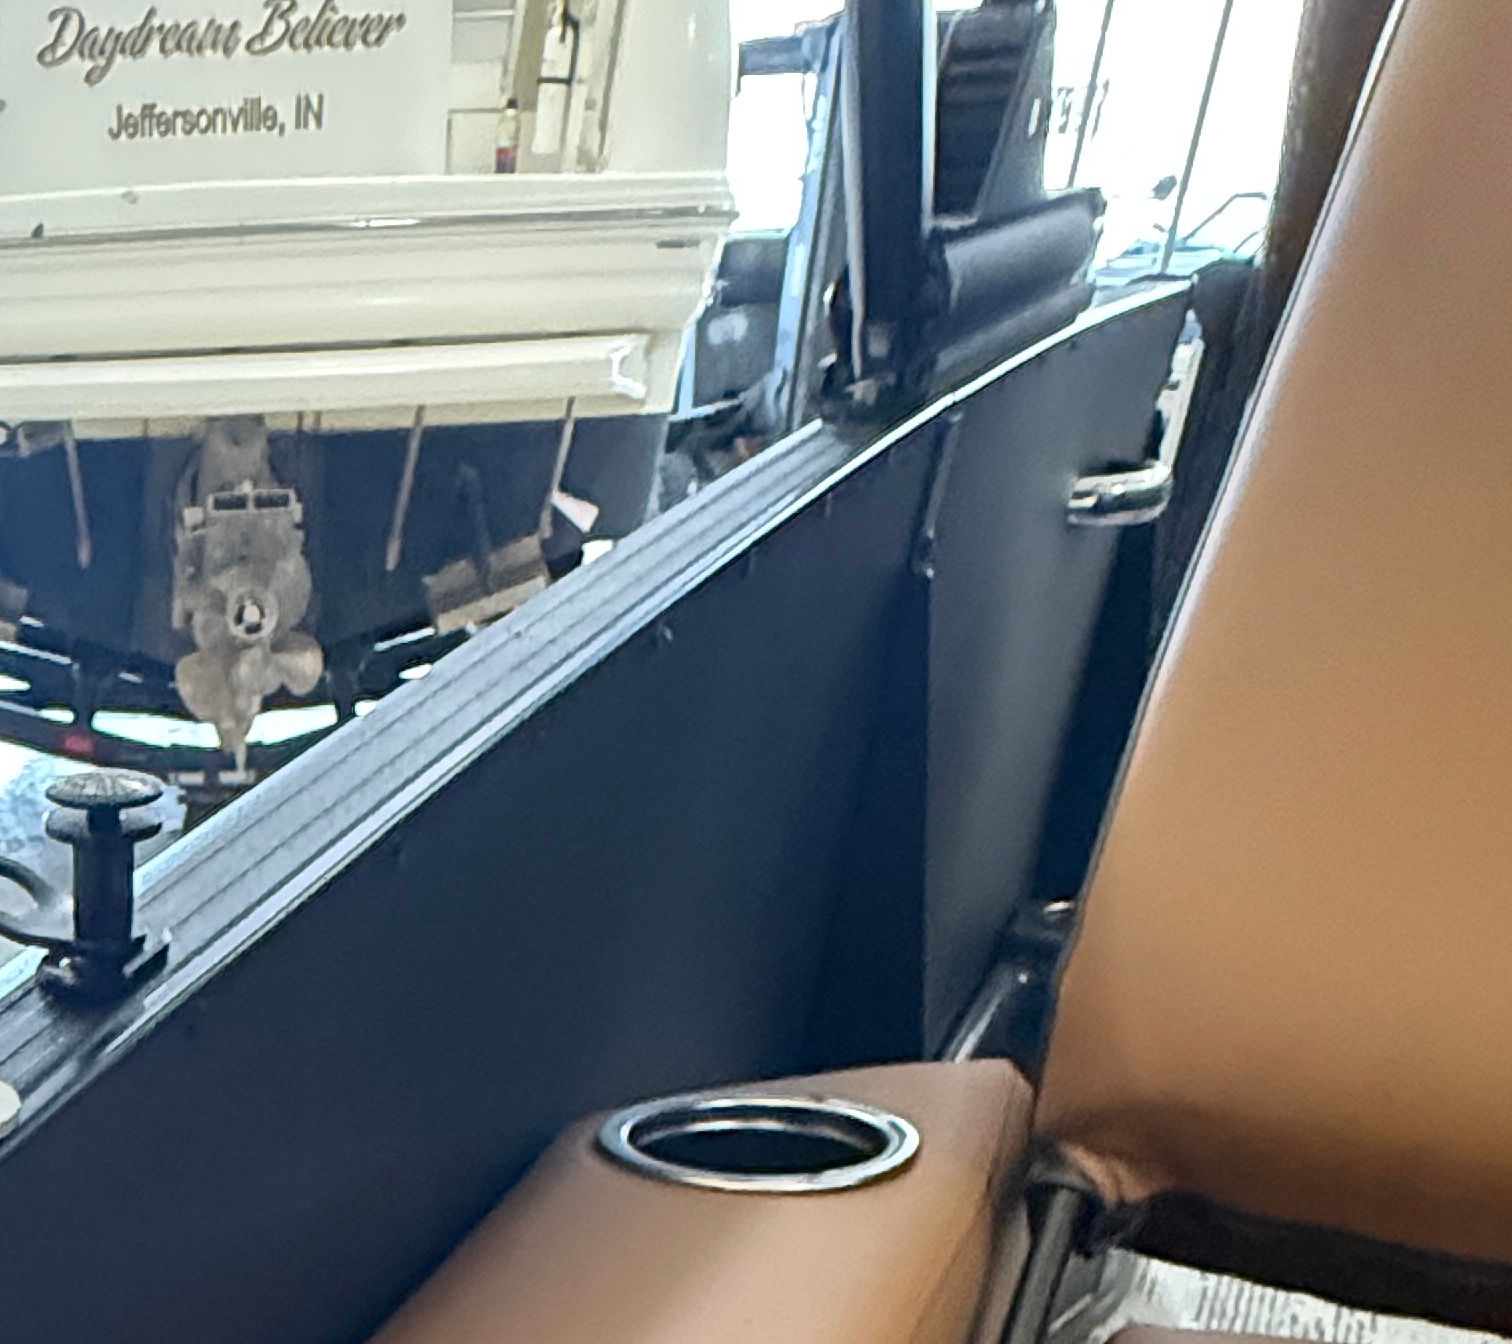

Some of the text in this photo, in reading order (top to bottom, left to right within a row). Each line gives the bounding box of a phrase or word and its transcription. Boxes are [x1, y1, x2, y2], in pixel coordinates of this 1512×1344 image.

[36, 0, 407, 87] Daydream Believer
[108, 93, 324, 140] Jeffersonville, IN
